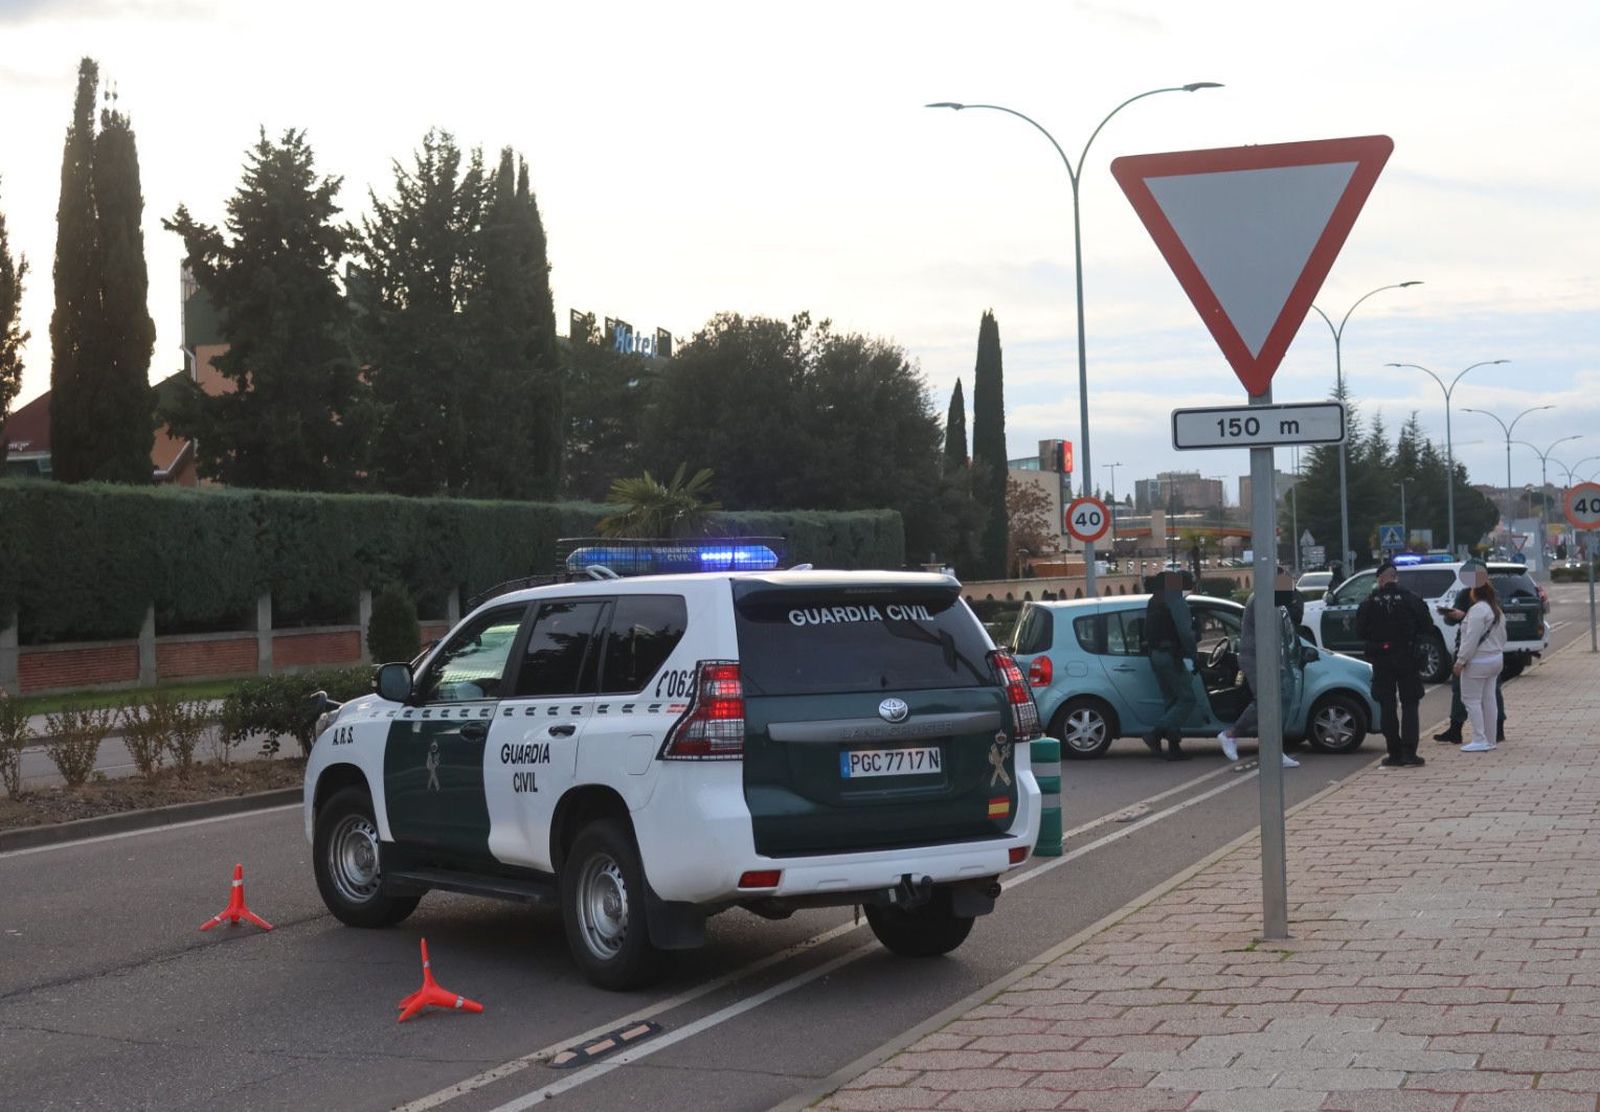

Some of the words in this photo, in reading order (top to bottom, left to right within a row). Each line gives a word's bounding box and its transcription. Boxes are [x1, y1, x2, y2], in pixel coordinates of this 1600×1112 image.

[1217, 417, 1260, 437] 150
[1280, 419, 1300, 434] m
[1575, 498, 1600, 514] 40
[1075, 511, 1101, 527] 40
[789, 606, 883, 626] GUARDIA
[886, 604, 934, 621] CIVIL
[667, 670, 697, 698] 062
[501, 743, 550, 764] GUARDIA
[851, 754, 881, 773] PGC
[885, 751, 925, 771] 7717
[928, 750, 940, 769] N
[513, 772, 539, 793] CIVIL
